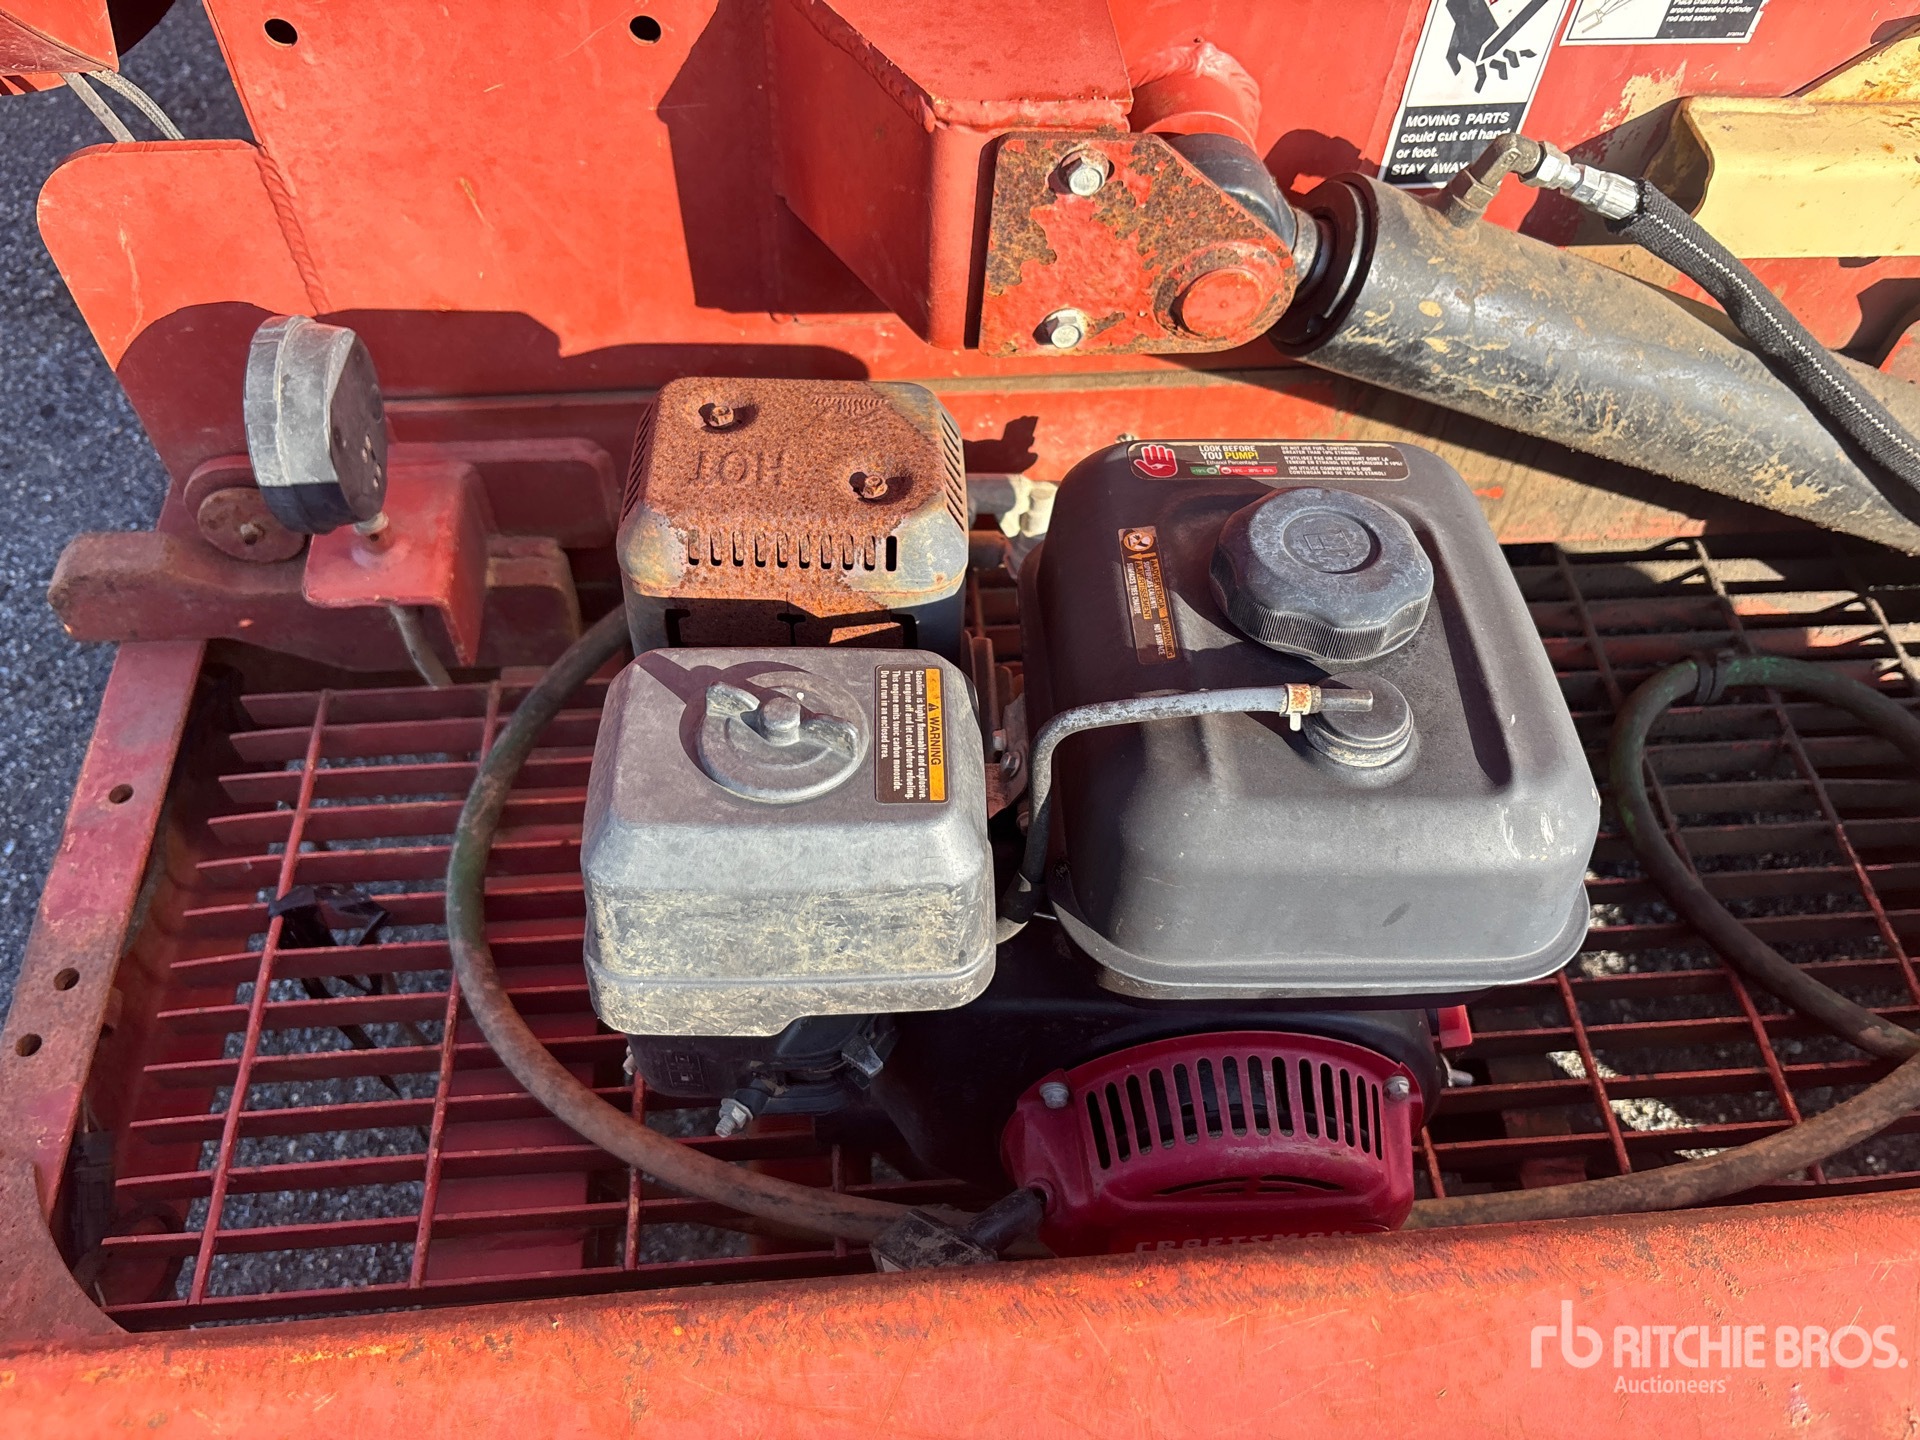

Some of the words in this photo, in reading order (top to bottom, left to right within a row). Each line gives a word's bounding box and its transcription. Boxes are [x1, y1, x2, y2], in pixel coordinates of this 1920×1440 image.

[1726, 6, 1754, 14] cylinder
[1405, 114, 1461, 128] MOVING
[1465, 112, 1511, 126] PARTS
[1400, 130, 1437, 144] could
[1437, 131, 1458, 142] cut
[1459, 128, 1478, 141] off
[1396, 148, 1411, 159] or
[1411, 146, 1439, 158] foot.
[1391, 162, 1427, 176] STAY
[1200, 452, 1222, 460] YOU
[1224, 451, 1260, 460] PUMP!
[687, 450, 786, 487] HOT
[1163, 626, 1174, 656] WARNING
[892, 670, 901, 682] This
[904, 670, 913, 682] Turn
[916, 670, 925, 695] Gasoline
[890, 684, 901, 703] engine
[903, 684, 913, 703] engine
[892, 704, 901, 720] emits
[905, 704, 914, 712] off
[915, 704, 926, 722] highly
[905, 713, 914, 724] and
[881, 716, 890, 743] enclosed
[893, 720, 902, 736] toxic
[906, 725, 914, 733] let
[906, 734, 915, 747] cool
[917, 723, 927, 754] flammable
[930, 716, 942, 766] WARNING
[893, 737, 902, 758] carbon
[906, 748, 915, 768] before
[918, 755, 927, 766] and
[893, 759, 902, 791] monoxide.
[904, 770, 916, 799] refueling.
[916, 767, 928, 800] explosive.
